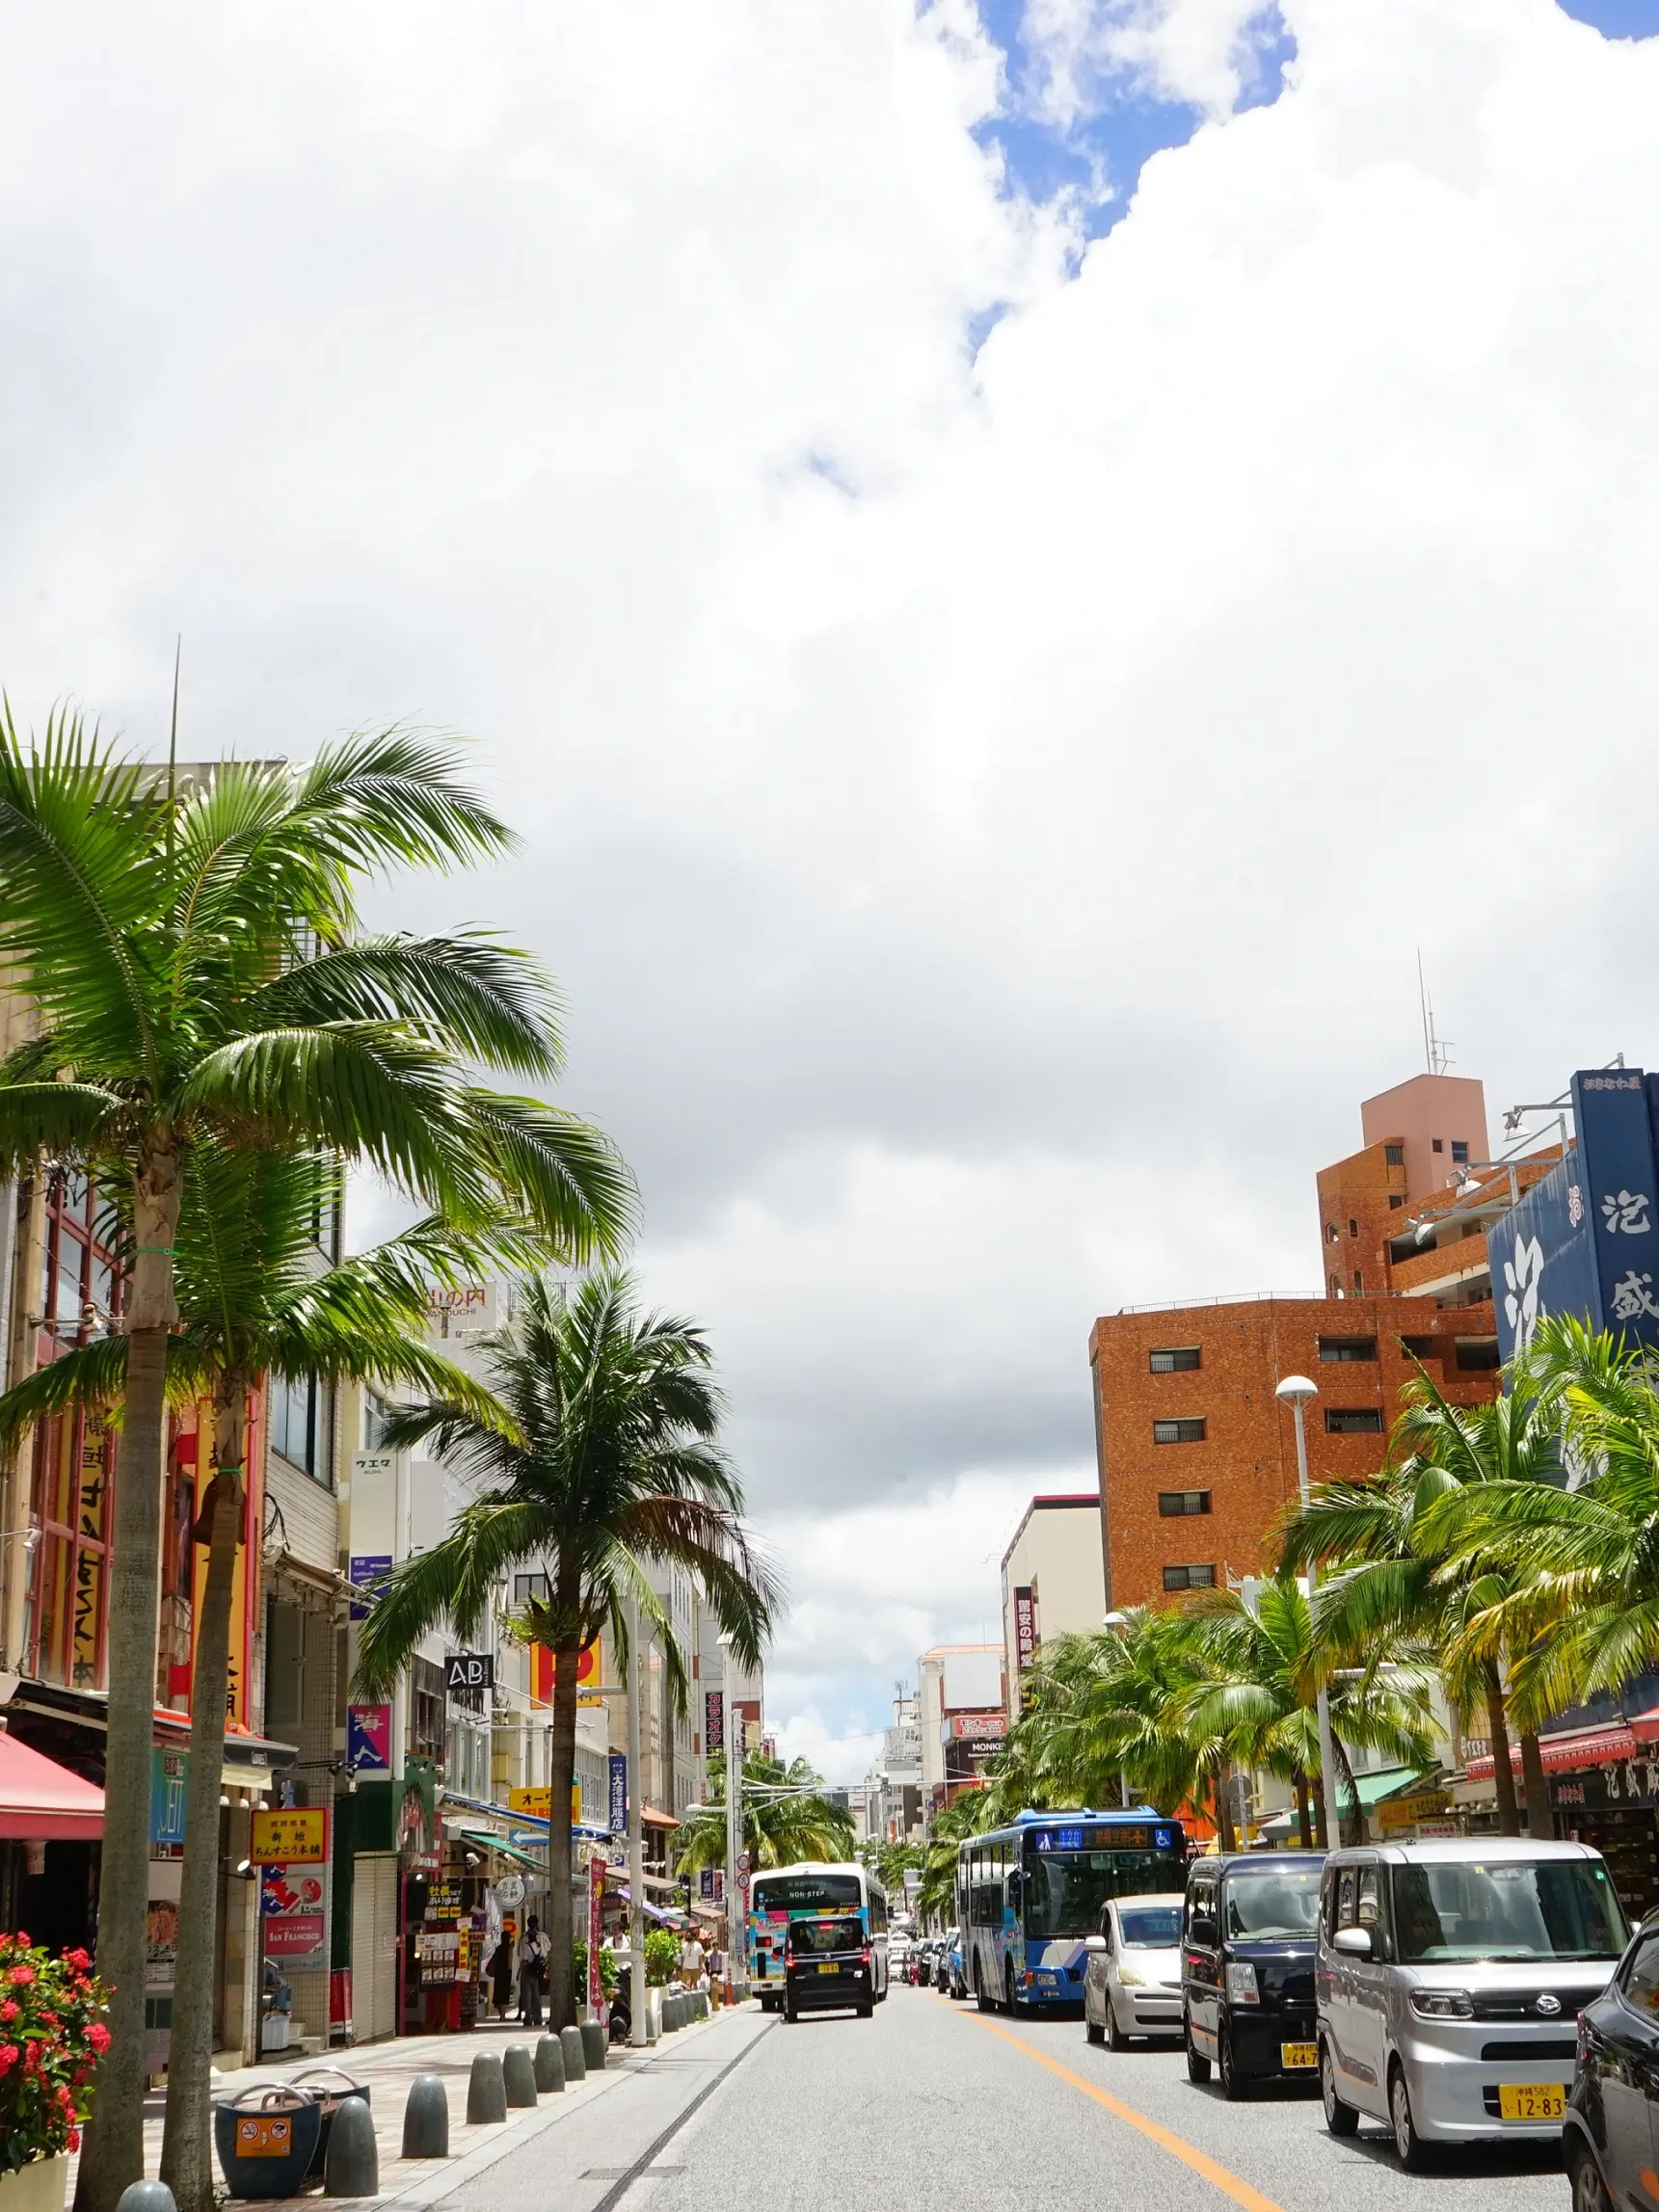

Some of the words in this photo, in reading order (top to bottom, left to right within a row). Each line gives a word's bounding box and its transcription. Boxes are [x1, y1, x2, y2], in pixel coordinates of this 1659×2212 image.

[709, 1693, 721, 1745] カラオケ
[1293, 2053, 1317, 2065] 64-7
[1517, 2098, 1562, 2117] 12-83
